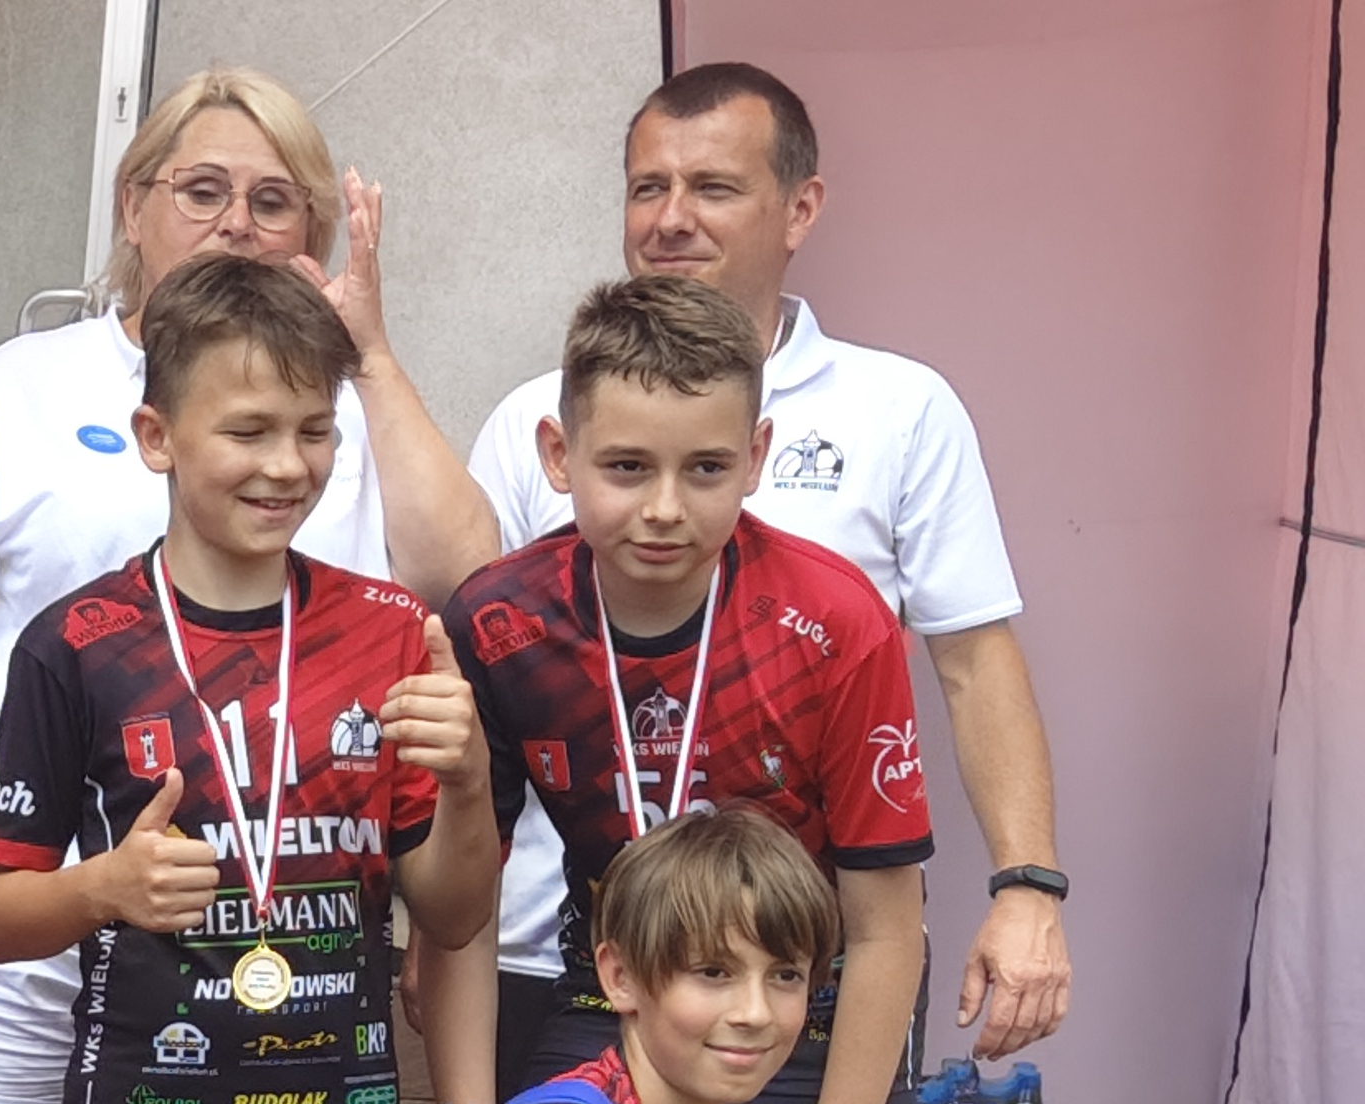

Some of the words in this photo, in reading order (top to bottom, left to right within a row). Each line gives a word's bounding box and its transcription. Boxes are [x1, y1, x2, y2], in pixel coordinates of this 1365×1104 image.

[364, 585, 426, 622] ZUGIL
[220, 700, 299, 788] 11
[80, 1023, 105, 1075] WKS
[355, 1021, 387, 1055] BKP
